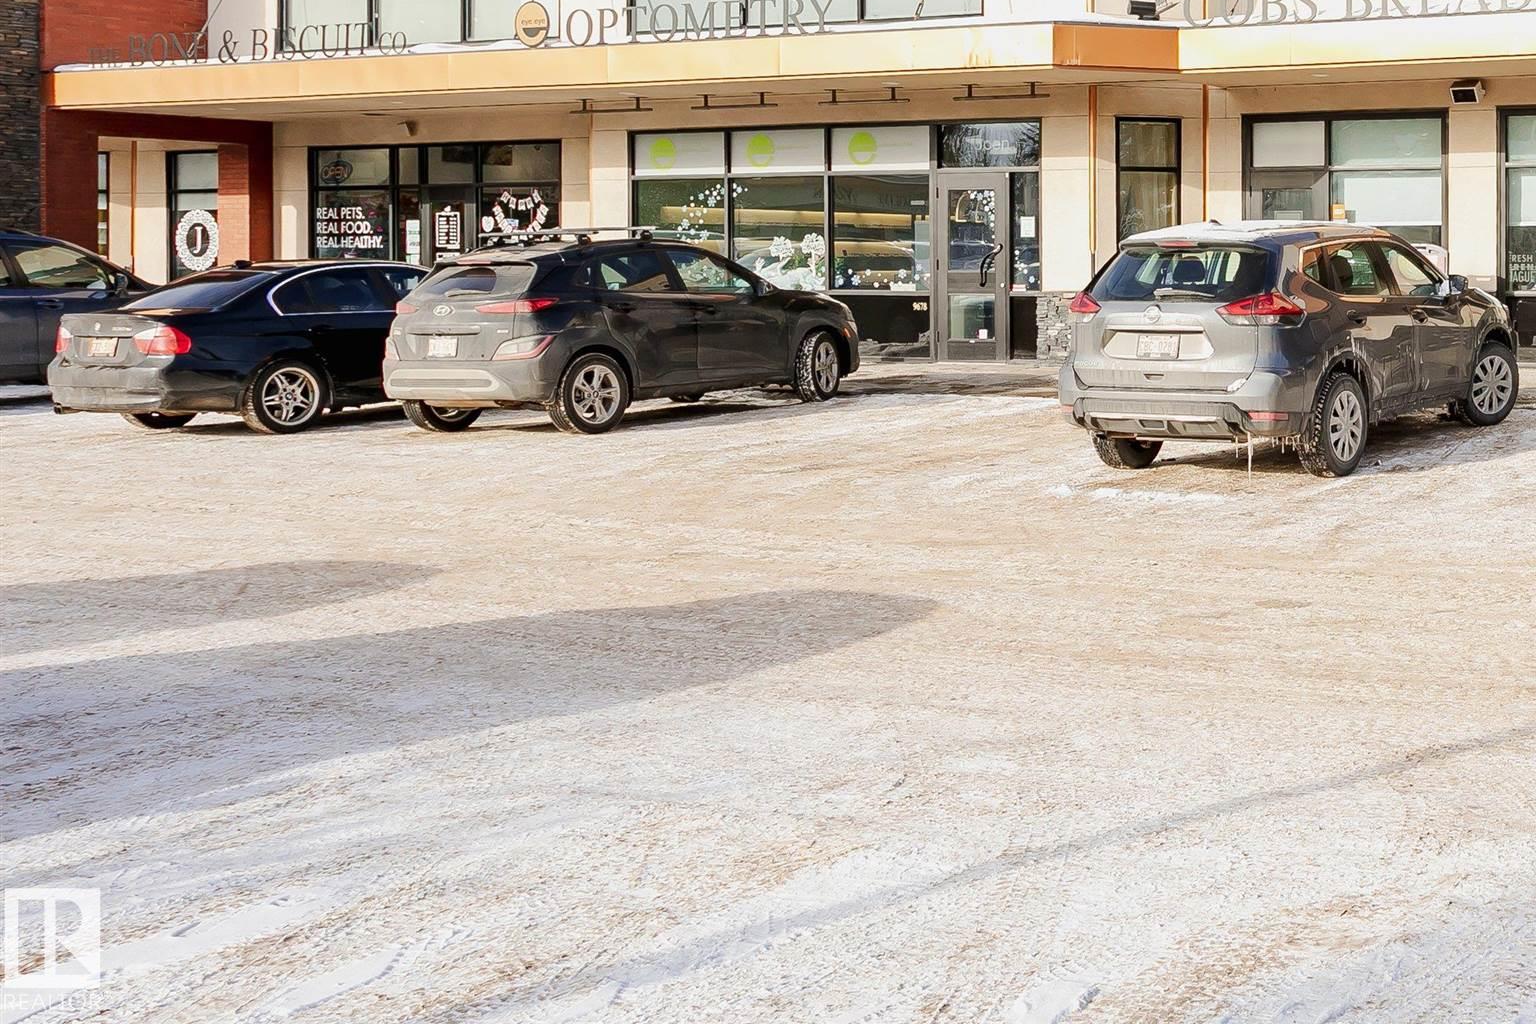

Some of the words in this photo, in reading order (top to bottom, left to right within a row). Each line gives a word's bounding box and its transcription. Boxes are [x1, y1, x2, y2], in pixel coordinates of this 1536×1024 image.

[87, 47, 122, 68] THE
[128, 32, 208, 67] BONE
[218, 29, 241, 64] &
[251, 22, 373, 62] BISCUIT
[322, 166, 350, 178] OPEN
[316, 207, 339, 219] REAL
[340, 206, 365, 220] PETS.
[316, 221, 339, 234] REAL
[340, 221, 373, 234] FOOD.
[192, 226, 203, 254] J
[316, 236, 340, 249] REAL
[341, 235, 384, 249] HEALTHY.
[912, 301, 928, 311] 9678
